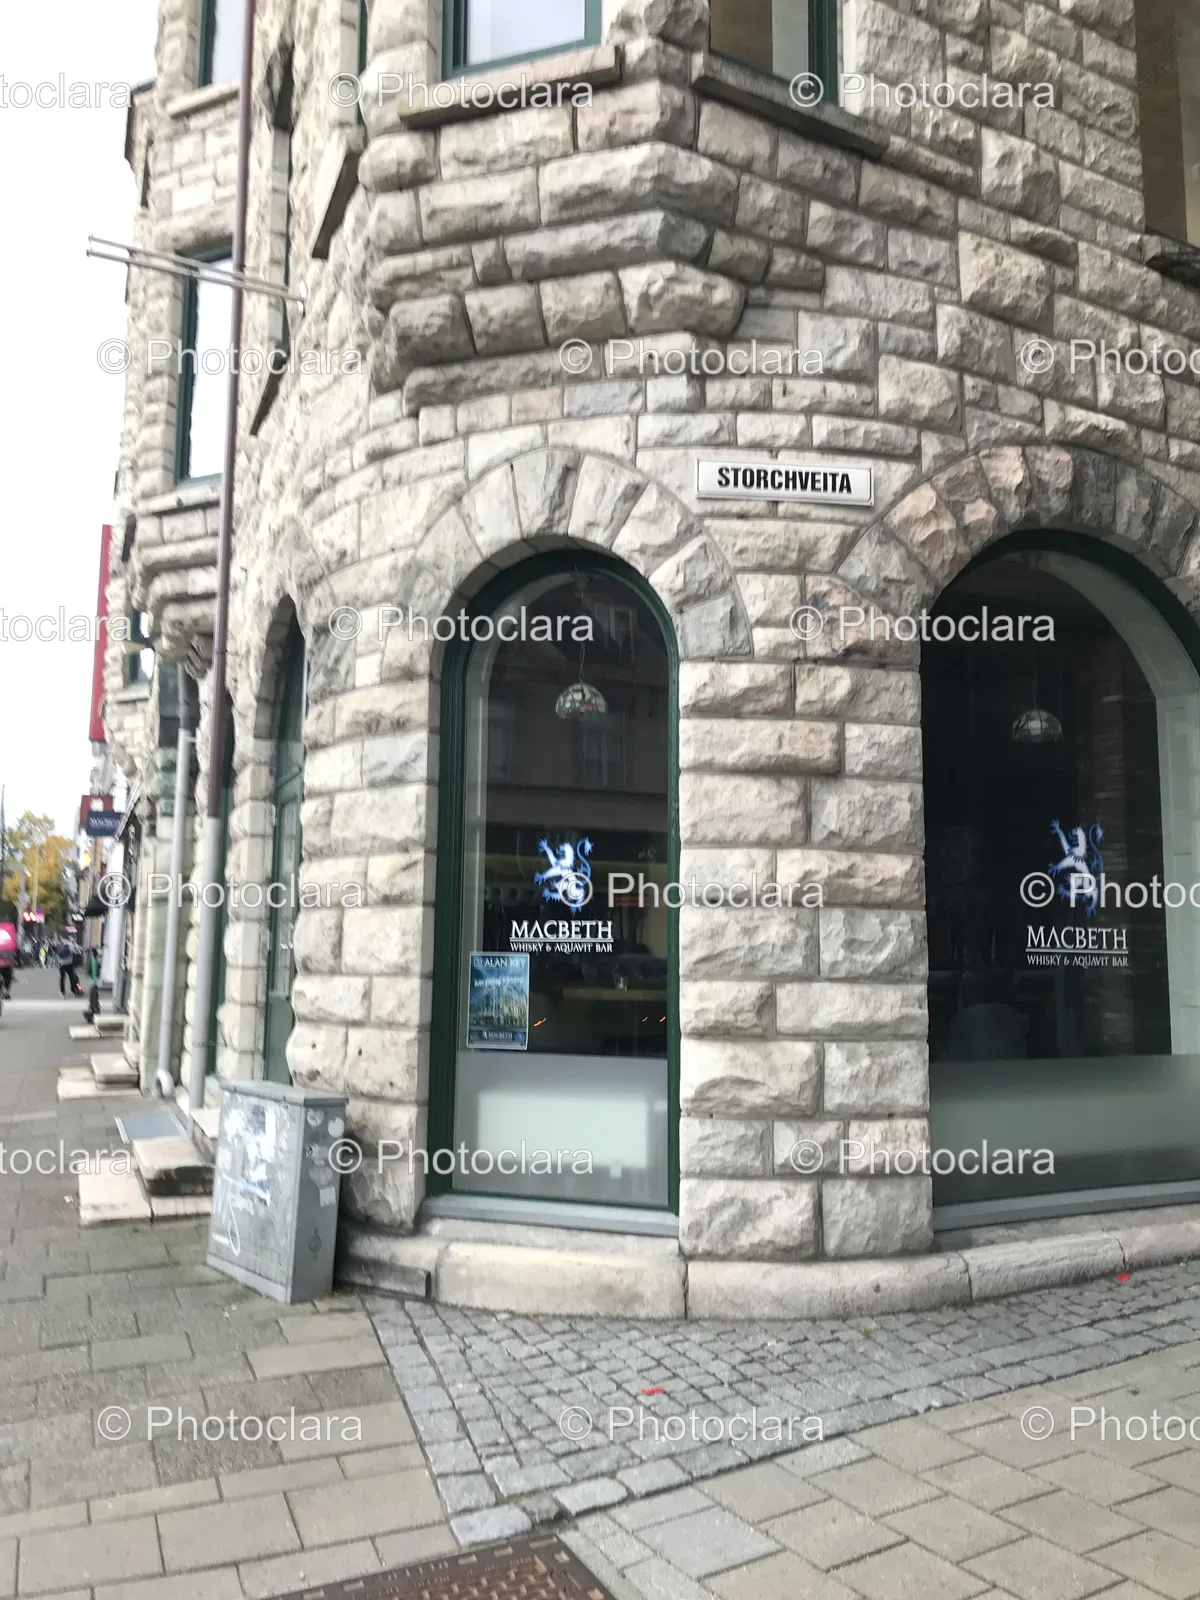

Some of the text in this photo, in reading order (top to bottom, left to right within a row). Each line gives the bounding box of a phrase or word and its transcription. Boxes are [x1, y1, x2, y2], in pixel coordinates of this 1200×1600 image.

[717, 466, 852, 495] STORCHVEITA
[511, 920, 613, 939] MACBETH
[1027, 925, 1128, 950] MACBETH
[510, 942, 544, 954] WHISKY
[554, 943, 592, 954] AQUAVIT
[596, 943, 613, 953] BAR
[484, 957, 508, 968] ALAN
[1027, 955, 1061, 966] WHISKY
[1072, 956, 1110, 969] AQUAVIT
[1112, 957, 1128, 966] BAR
